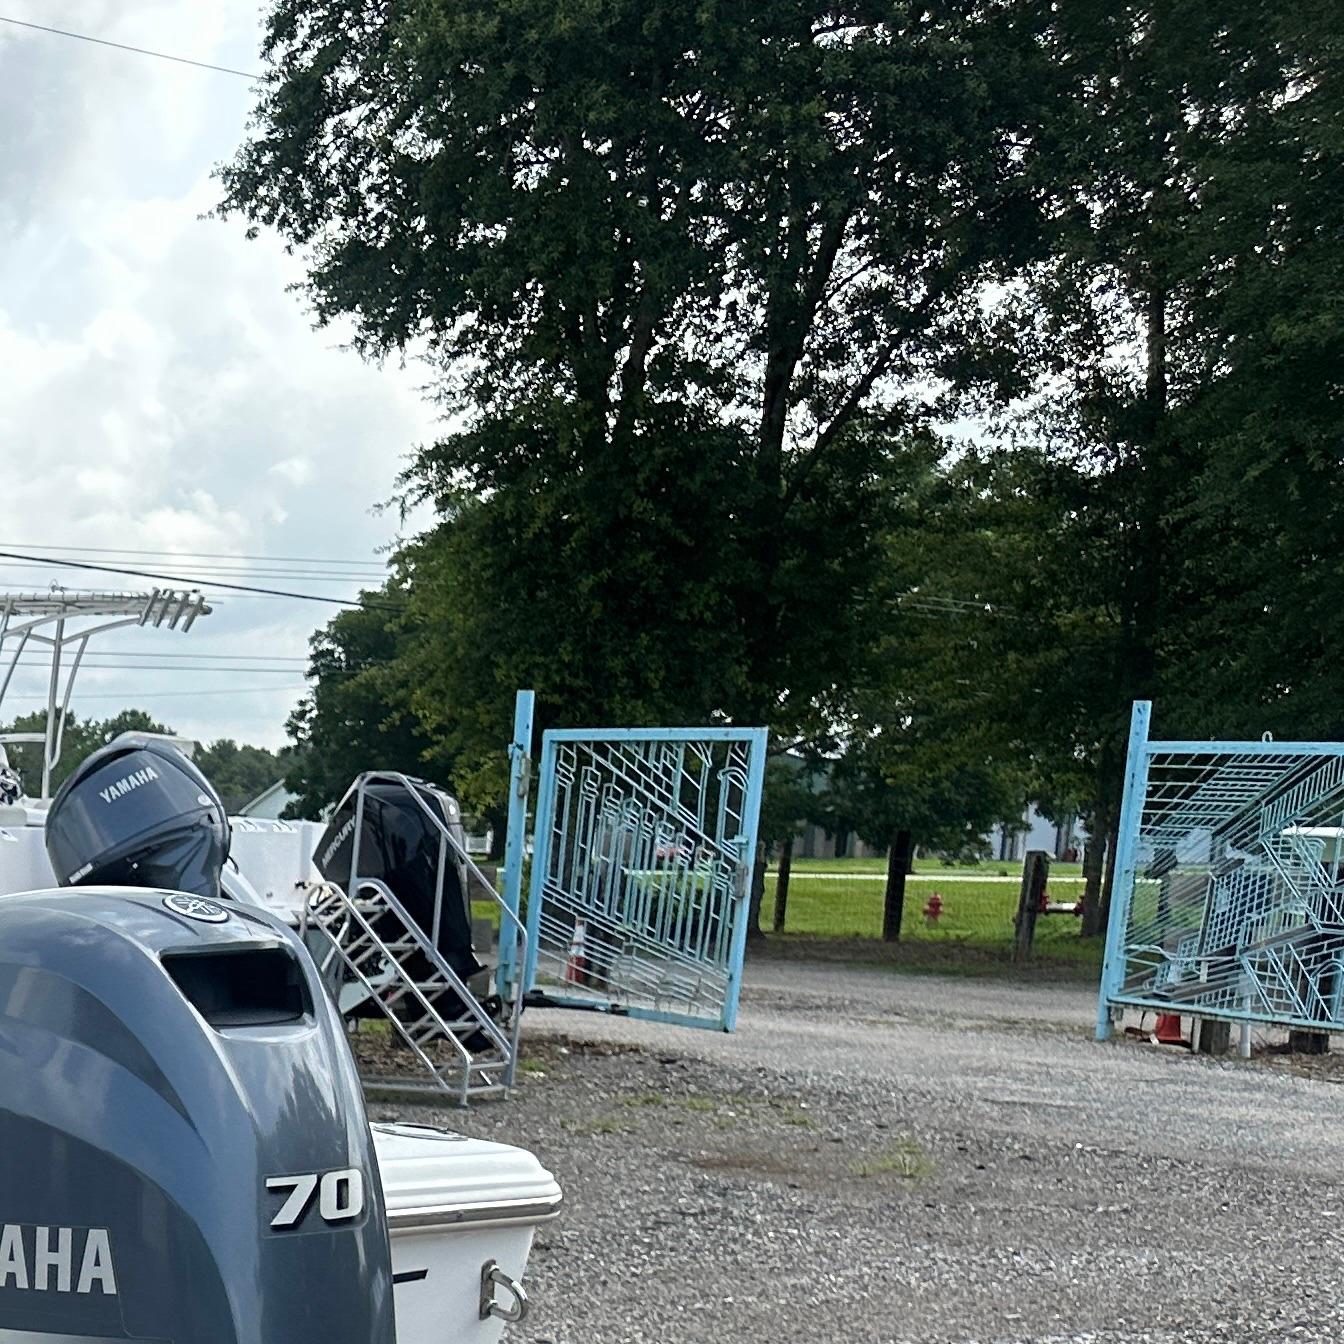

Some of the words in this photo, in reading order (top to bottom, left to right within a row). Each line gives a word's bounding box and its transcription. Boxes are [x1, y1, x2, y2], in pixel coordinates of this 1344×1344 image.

[99, 766, 160, 804] YAMAHA
[321, 814, 356, 869] MERCURY
[265, 1169, 364, 1227] 70
